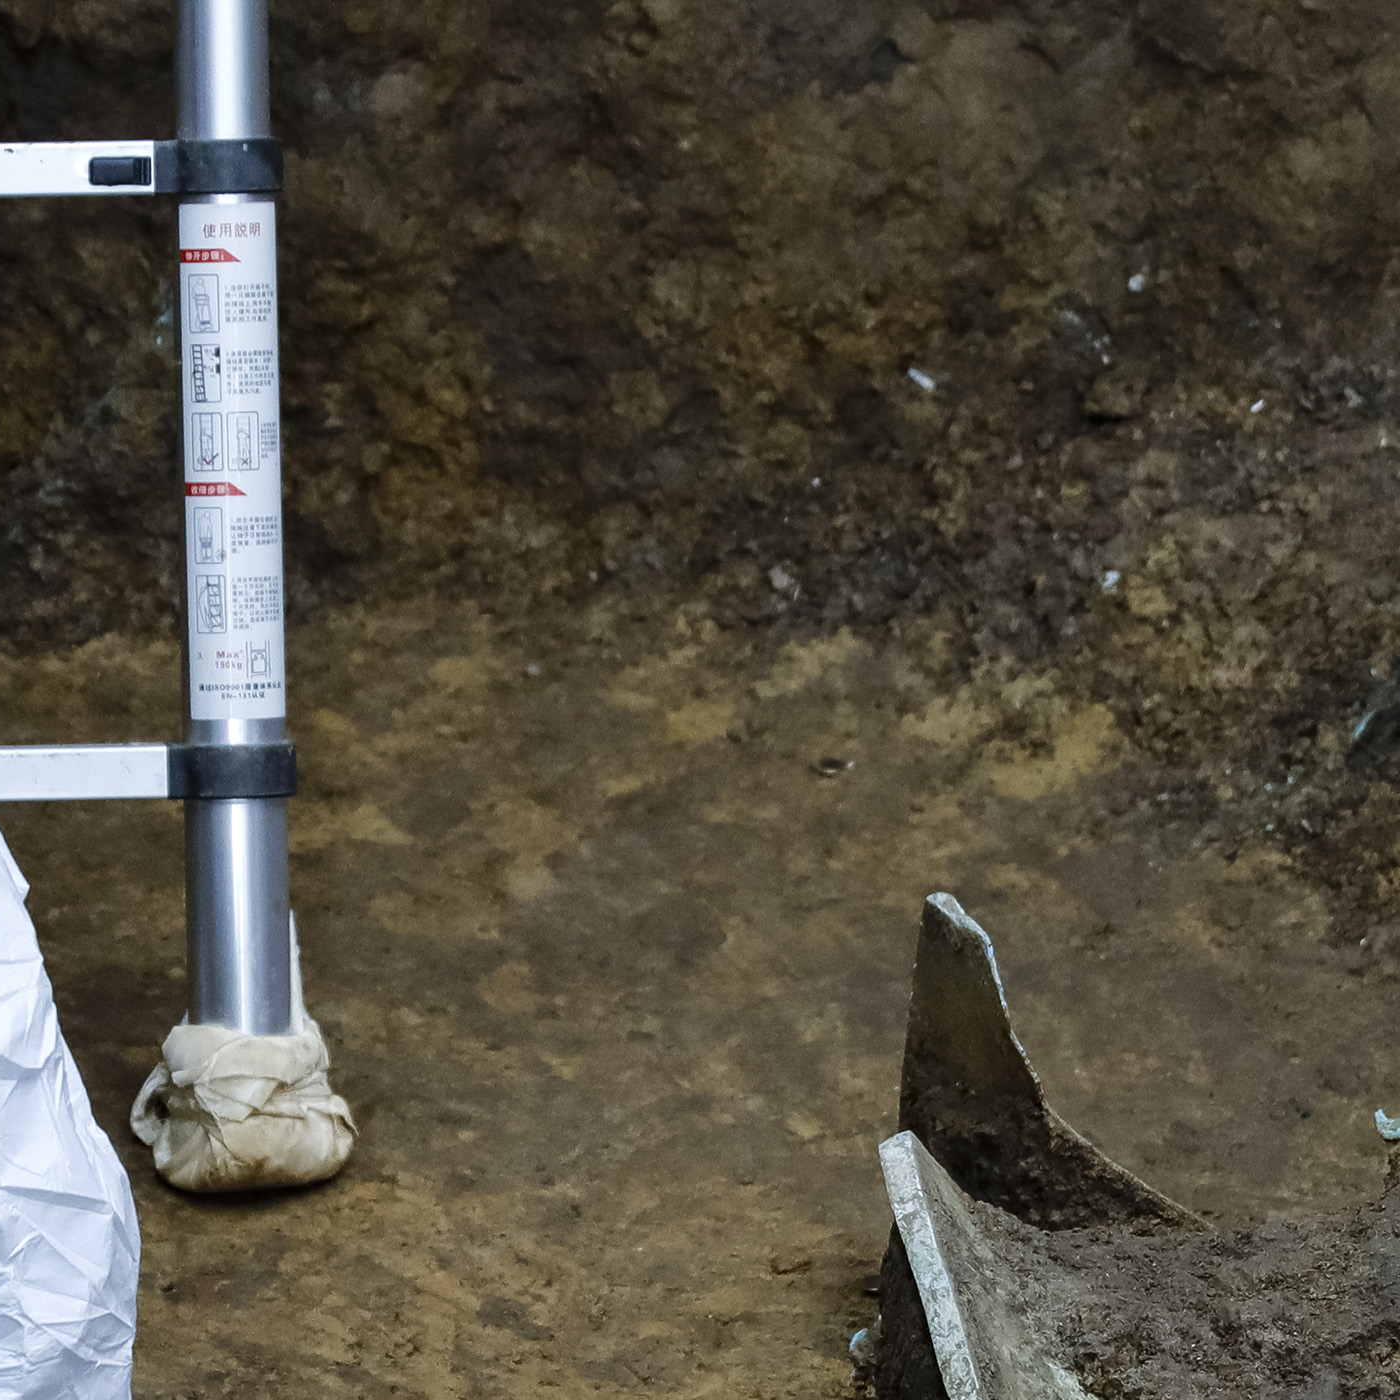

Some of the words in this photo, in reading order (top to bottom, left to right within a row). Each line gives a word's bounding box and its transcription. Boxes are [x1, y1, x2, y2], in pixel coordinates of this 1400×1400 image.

[203, 222, 261, 238] 使用説明
[215, 661, 242, 670] 150kg
